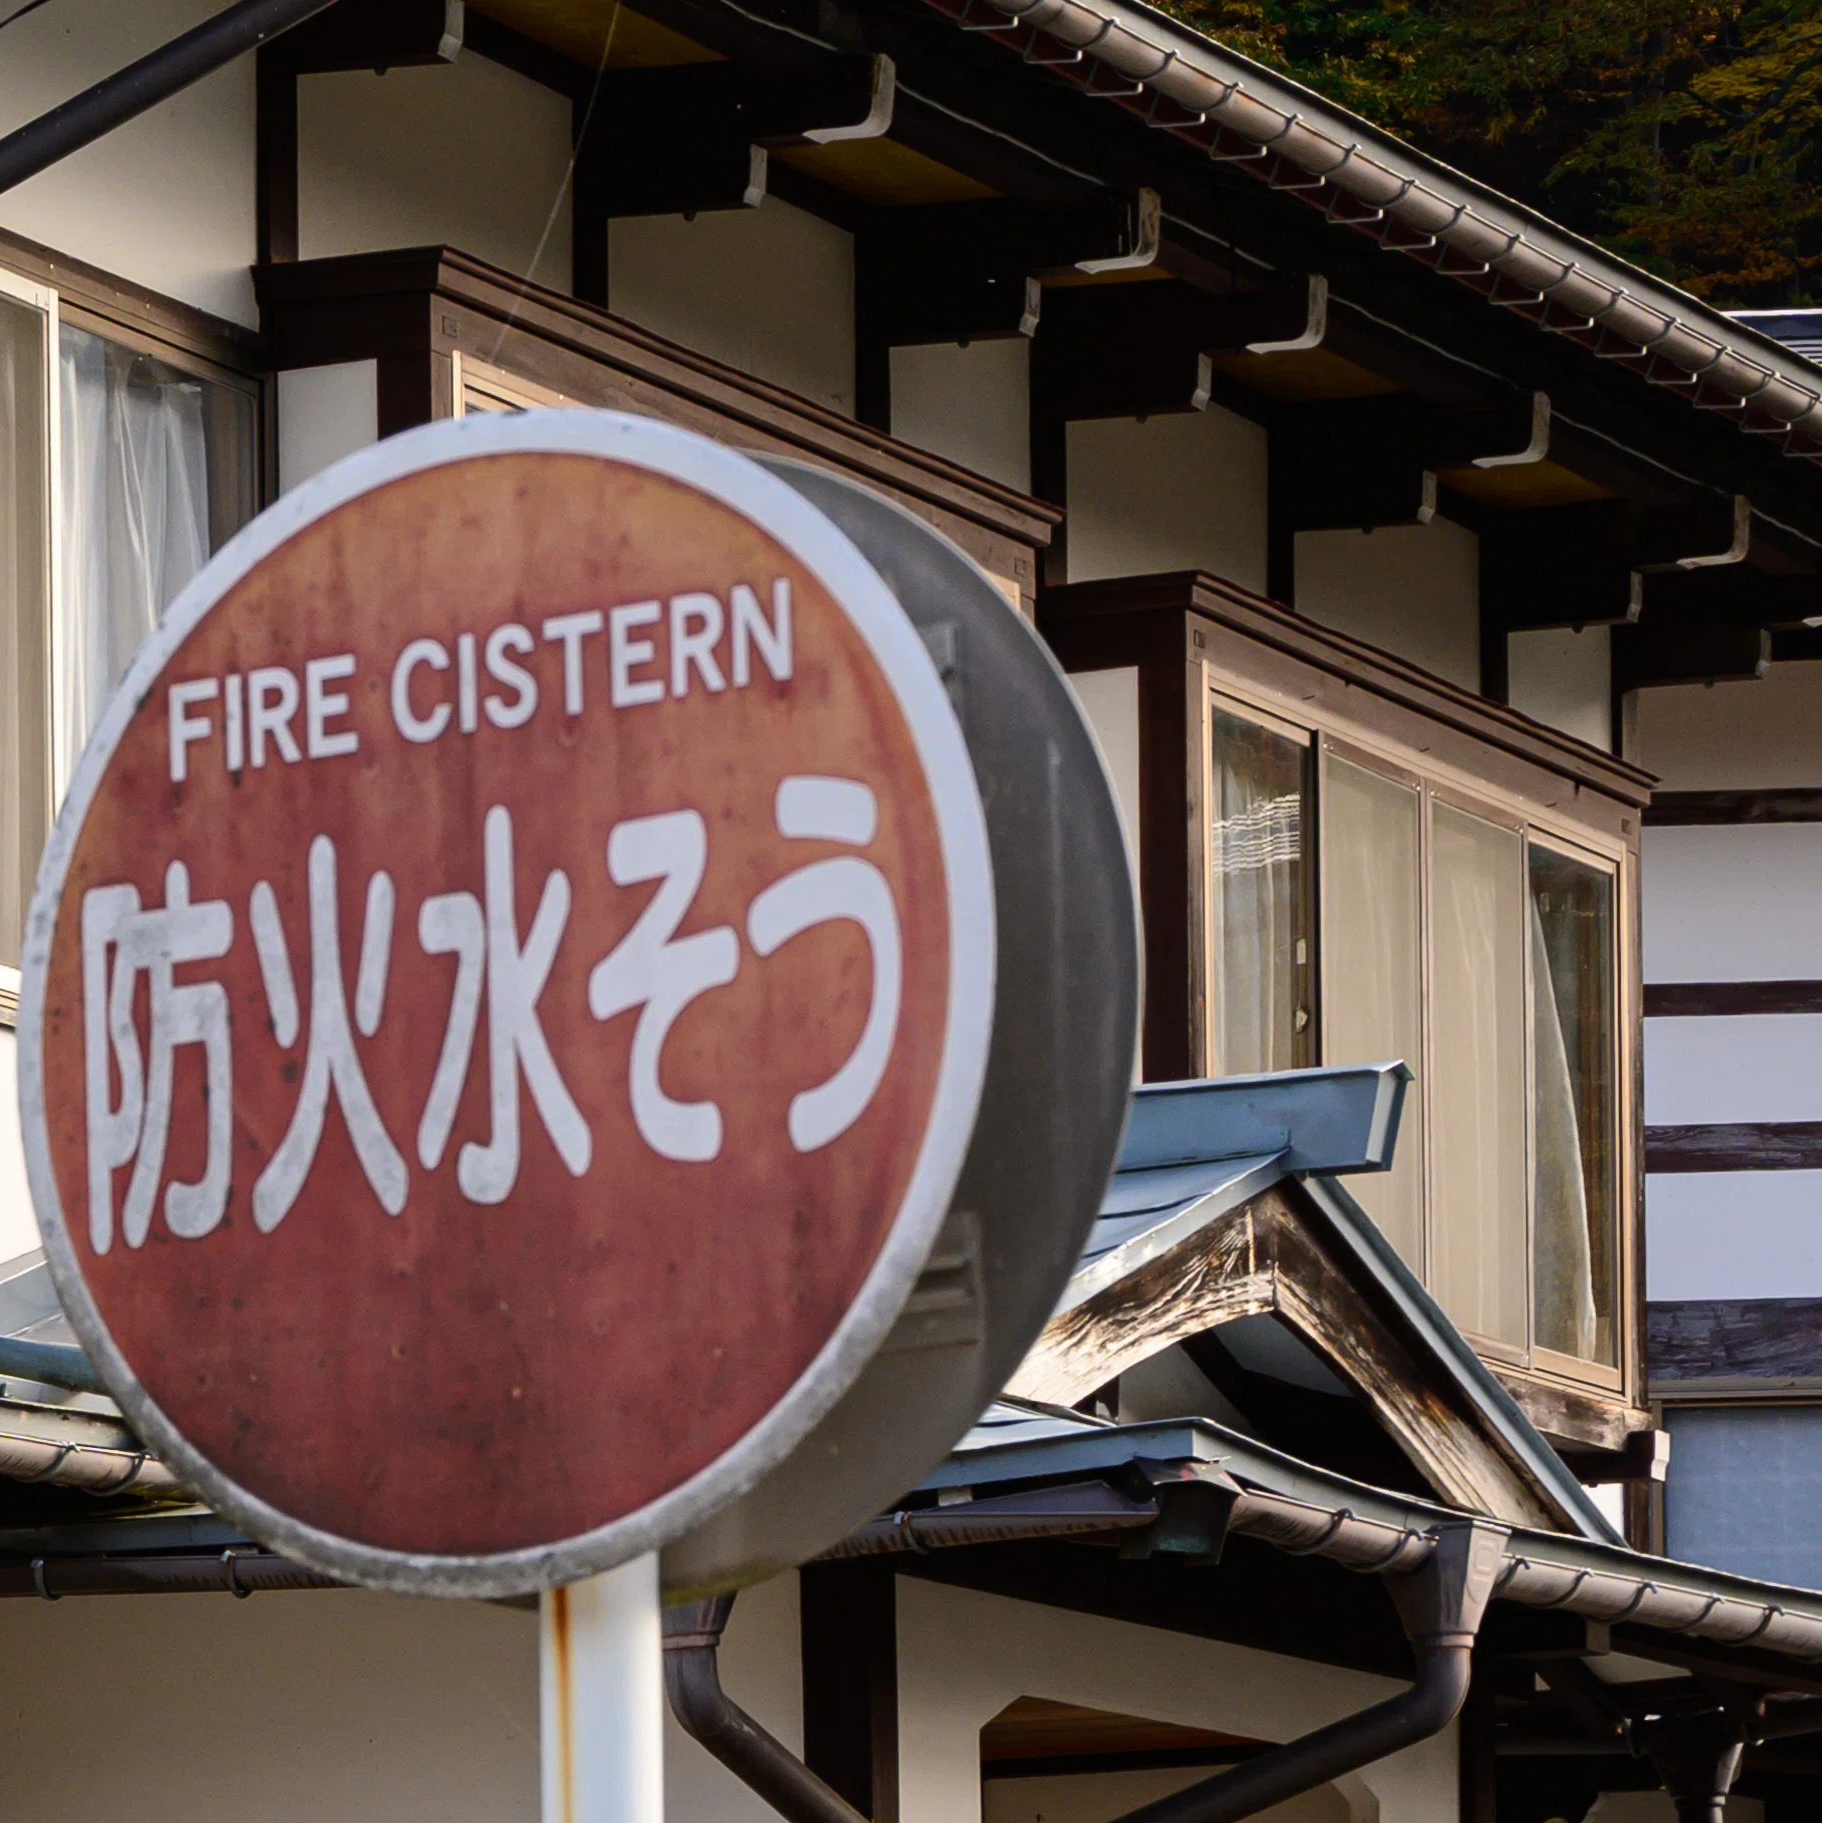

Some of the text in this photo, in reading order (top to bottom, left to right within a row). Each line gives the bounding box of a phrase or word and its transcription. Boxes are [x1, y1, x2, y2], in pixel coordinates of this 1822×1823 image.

[168, 578, 794, 782] FIRE CISTERN
[82, 776, 902, 1255] 防火水そう
